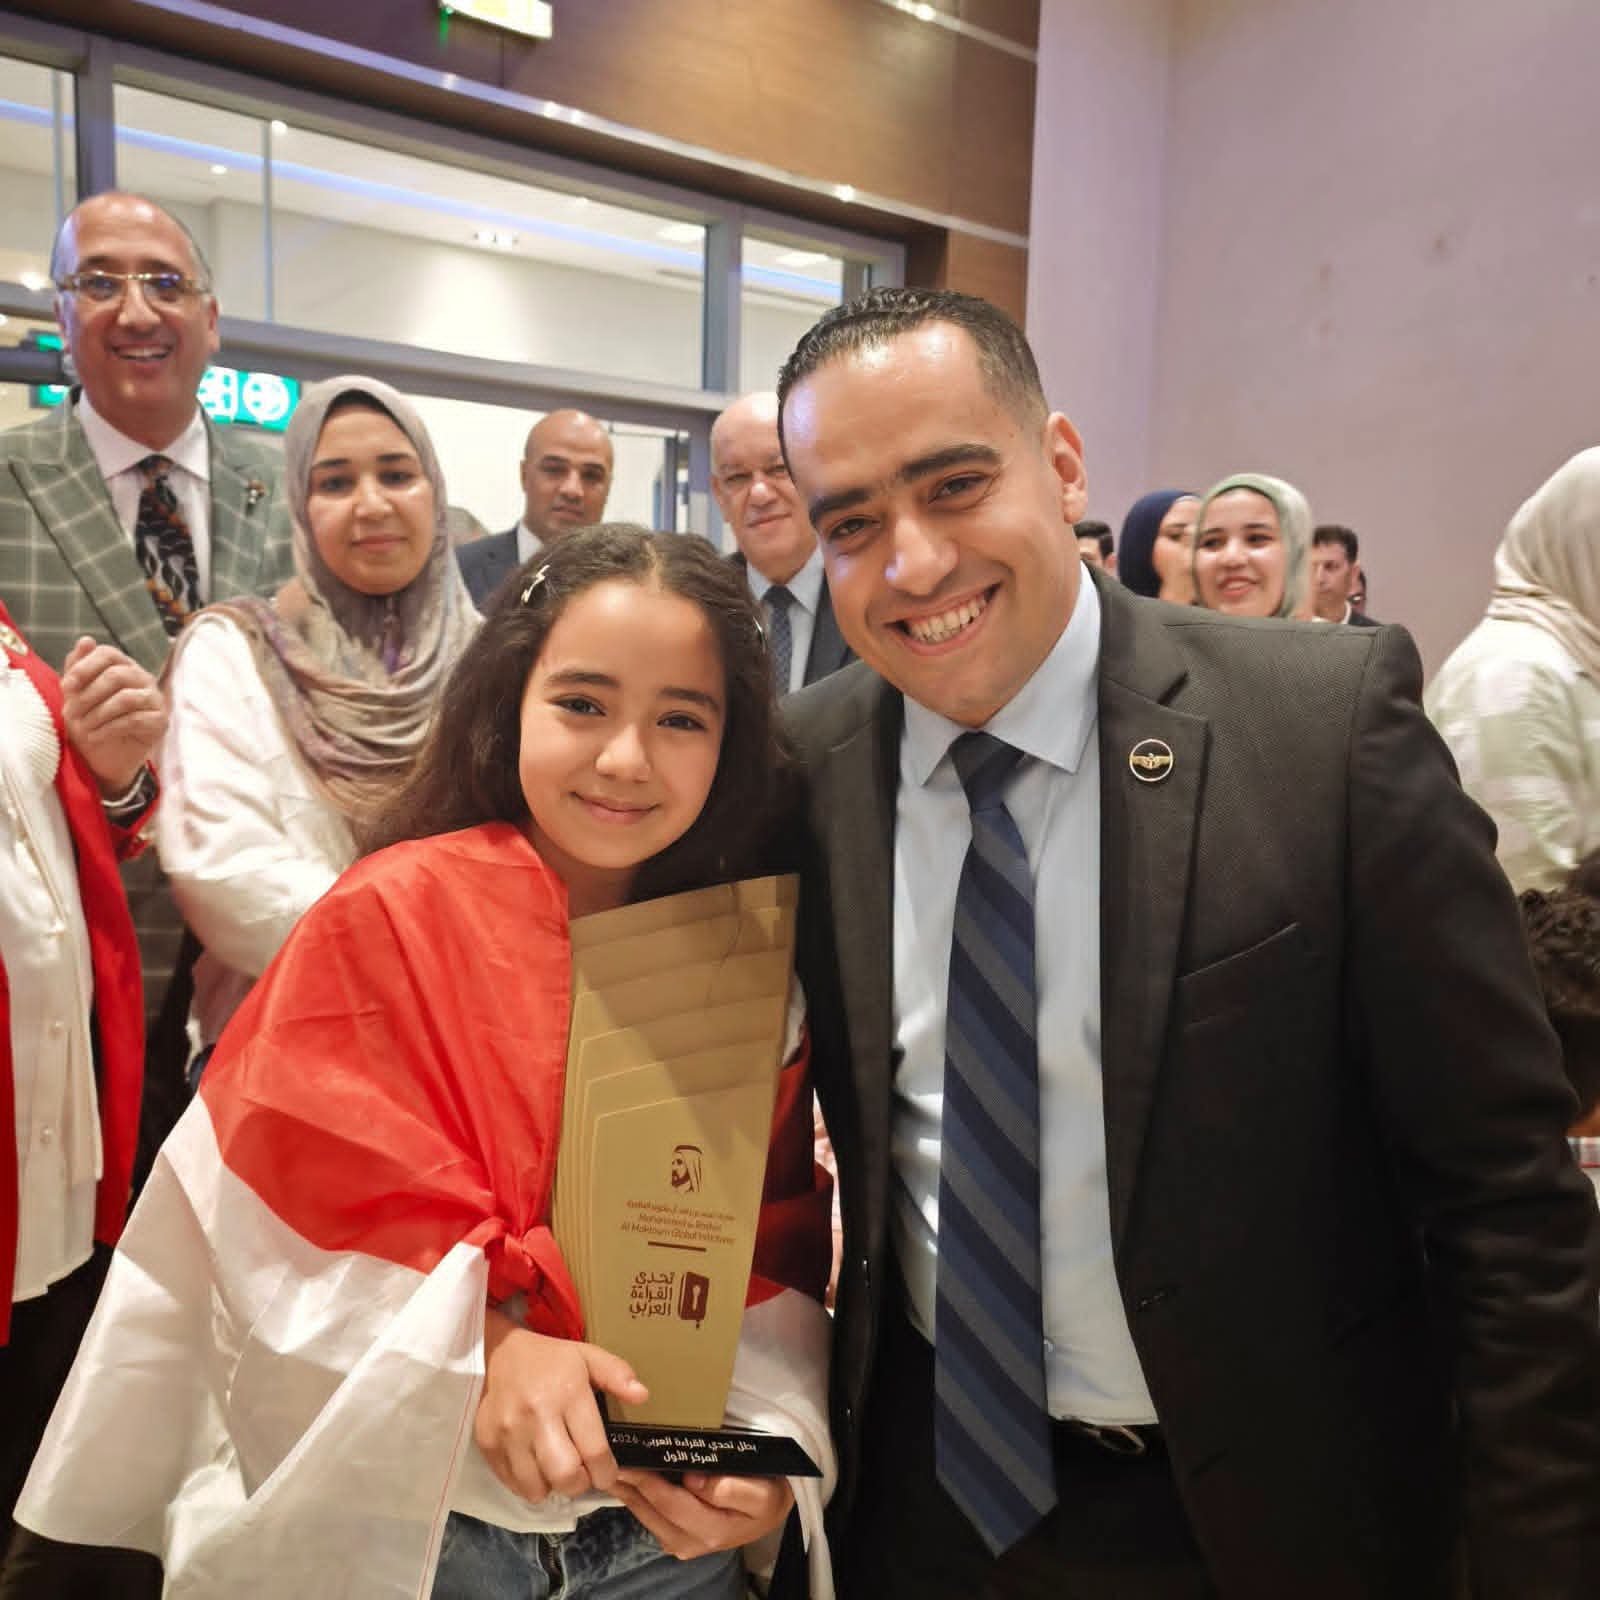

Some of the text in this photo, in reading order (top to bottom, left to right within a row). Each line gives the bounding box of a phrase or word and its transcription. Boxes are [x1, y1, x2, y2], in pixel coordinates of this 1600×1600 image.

[631, 1284, 673, 1302] القراءة
[629, 1301, 671, 1318] العربي
[674, 1437, 706, 1449] القراءة
[737, 1440, 758, 1452] بطل
[663, 1449, 719, 1463] المركز الأول
